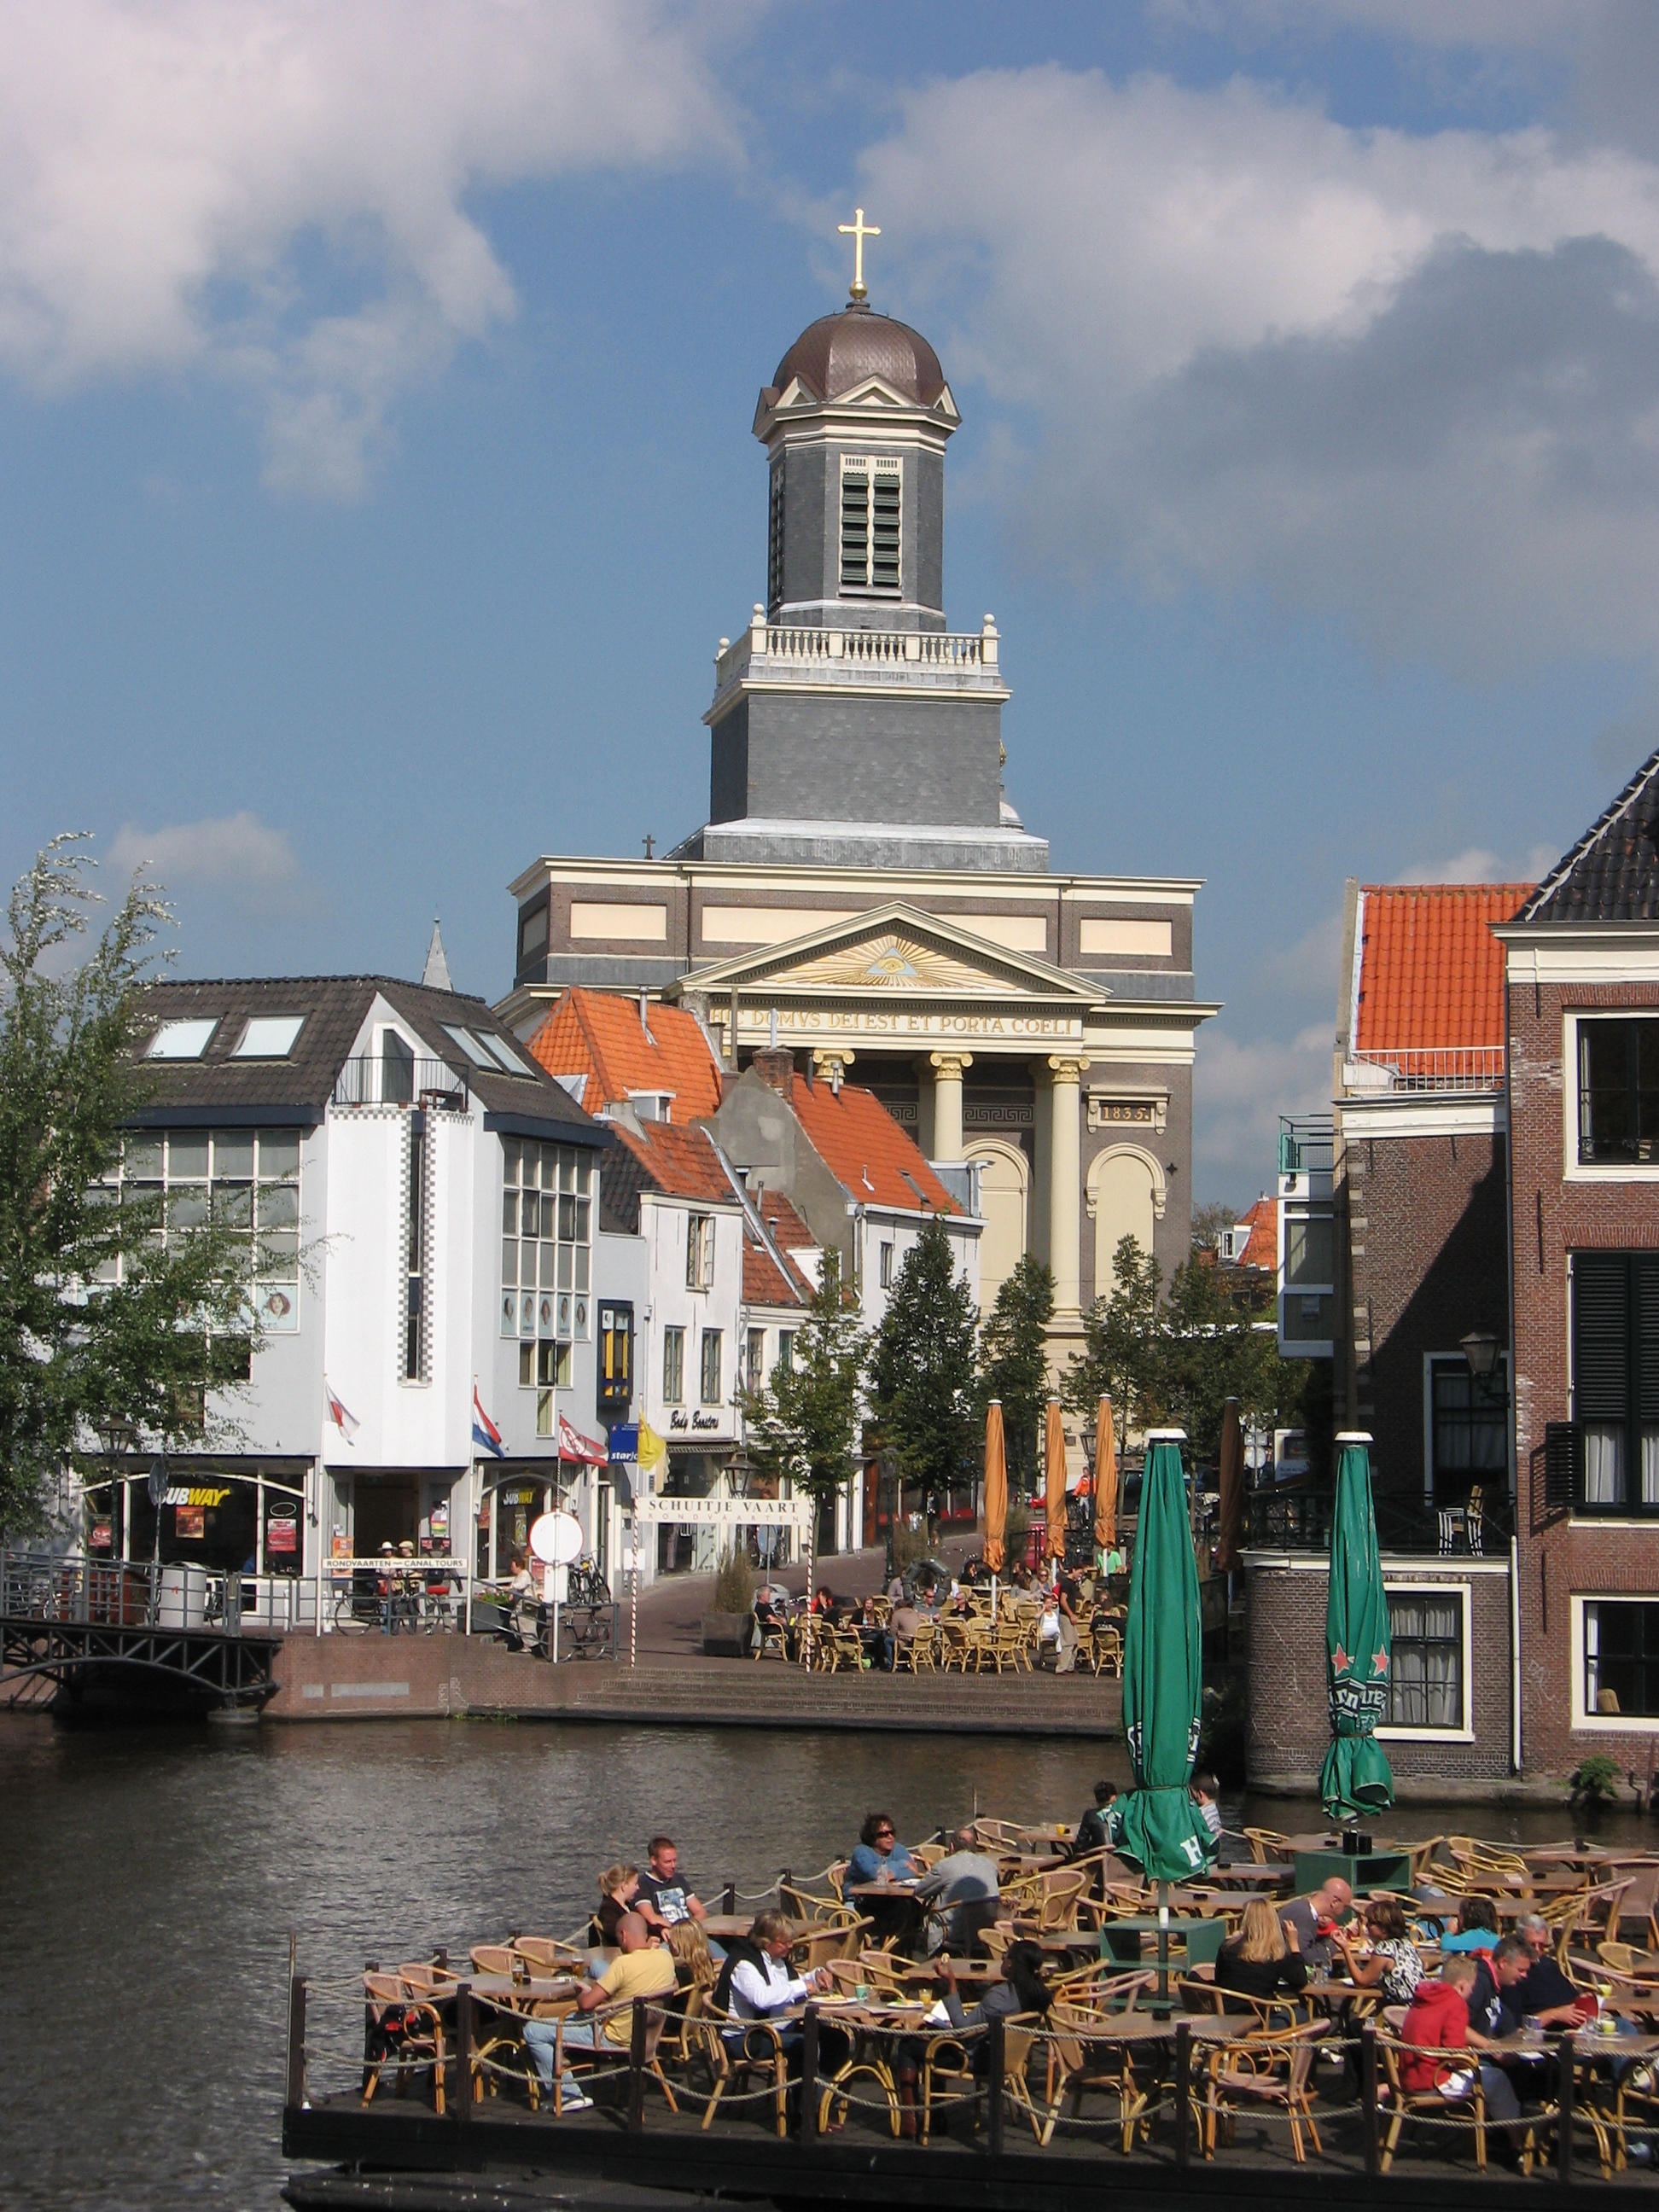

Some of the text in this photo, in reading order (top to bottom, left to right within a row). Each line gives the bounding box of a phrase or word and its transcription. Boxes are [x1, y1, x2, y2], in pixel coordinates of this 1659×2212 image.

[752, 1010, 820, 1027] DOMVS
[828, 1011, 859, 1029] DEI
[864, 1013, 899, 1030] EST
[907, 1014, 932, 1031] ET
[940, 1016, 1004, 1033] PORTA
[1011, 1018, 1071, 1035] COELI
[648, 1499, 799, 1514] SCHUITJE VAART
[648, 1513, 800, 1522] RONDVAARTEN
